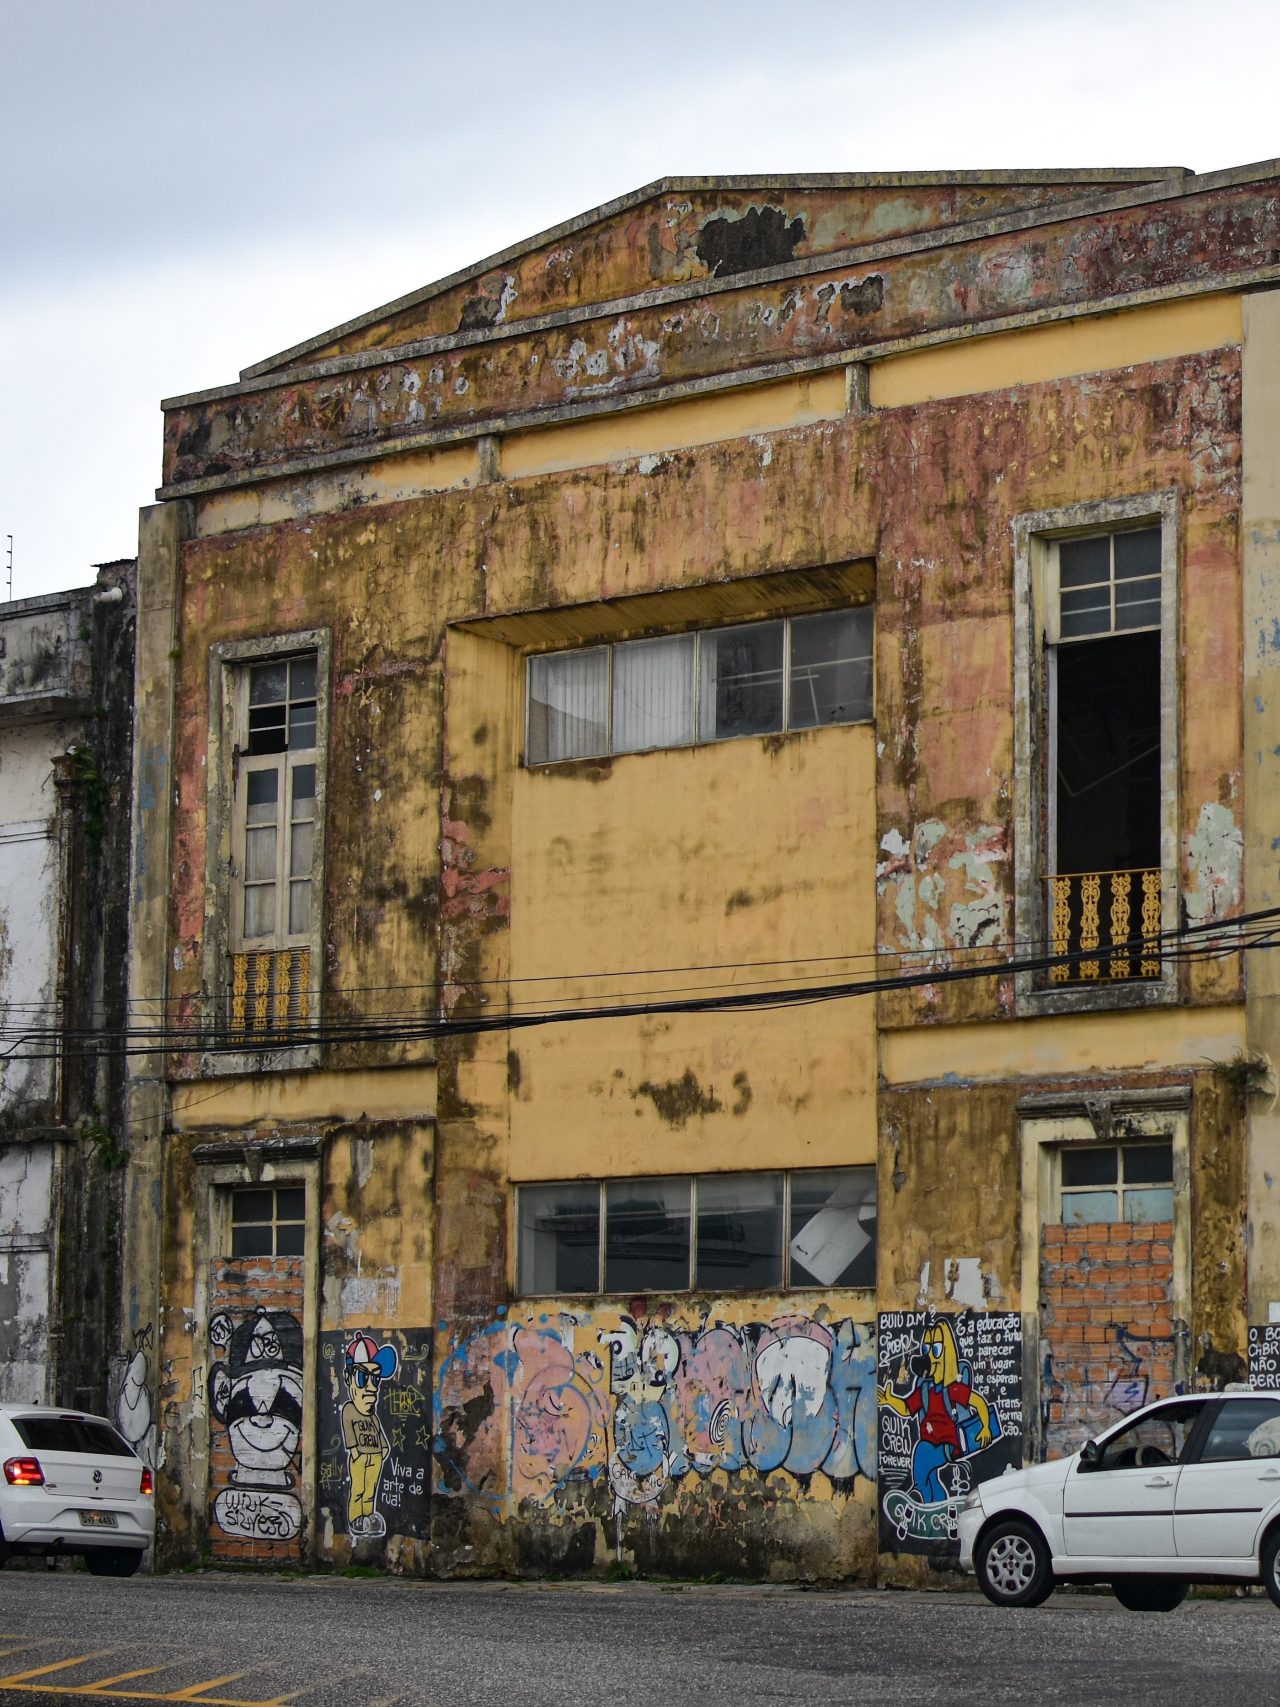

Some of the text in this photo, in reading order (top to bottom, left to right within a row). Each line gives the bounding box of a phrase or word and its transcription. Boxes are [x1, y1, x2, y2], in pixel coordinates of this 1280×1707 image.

[880, 1310, 904, 1329] BUIÚ
[967, 1320, 975, 1333] a
[976, 1312, 1020, 1331] educação
[959, 1336, 974, 1350] que
[977, 1332, 992, 1344] faz
[995, 1333, 1001, 1342] o
[1249, 1327, 1258, 1341] O
[978, 1345, 1015, 1361] parecer
[972, 1358, 1015, 1373] um lugar
[1250, 1356, 1277, 1371] NÃO
[974, 1373, 984, 1384] de
[1000, 1386, 1007, 1395] e
[999, 1409, 1022, 1421] forma
[882, 1415, 911, 1435] QUIK
[882, 1433, 912, 1454] CREW
[879, 1451, 911, 1467] FOREVER
[391, 1457, 425, 1480] Viva a
[384, 1477, 423, 1495] arte de
[382, 1492, 401, 1507] rua!
[894, 1503, 926, 1531] QIK
